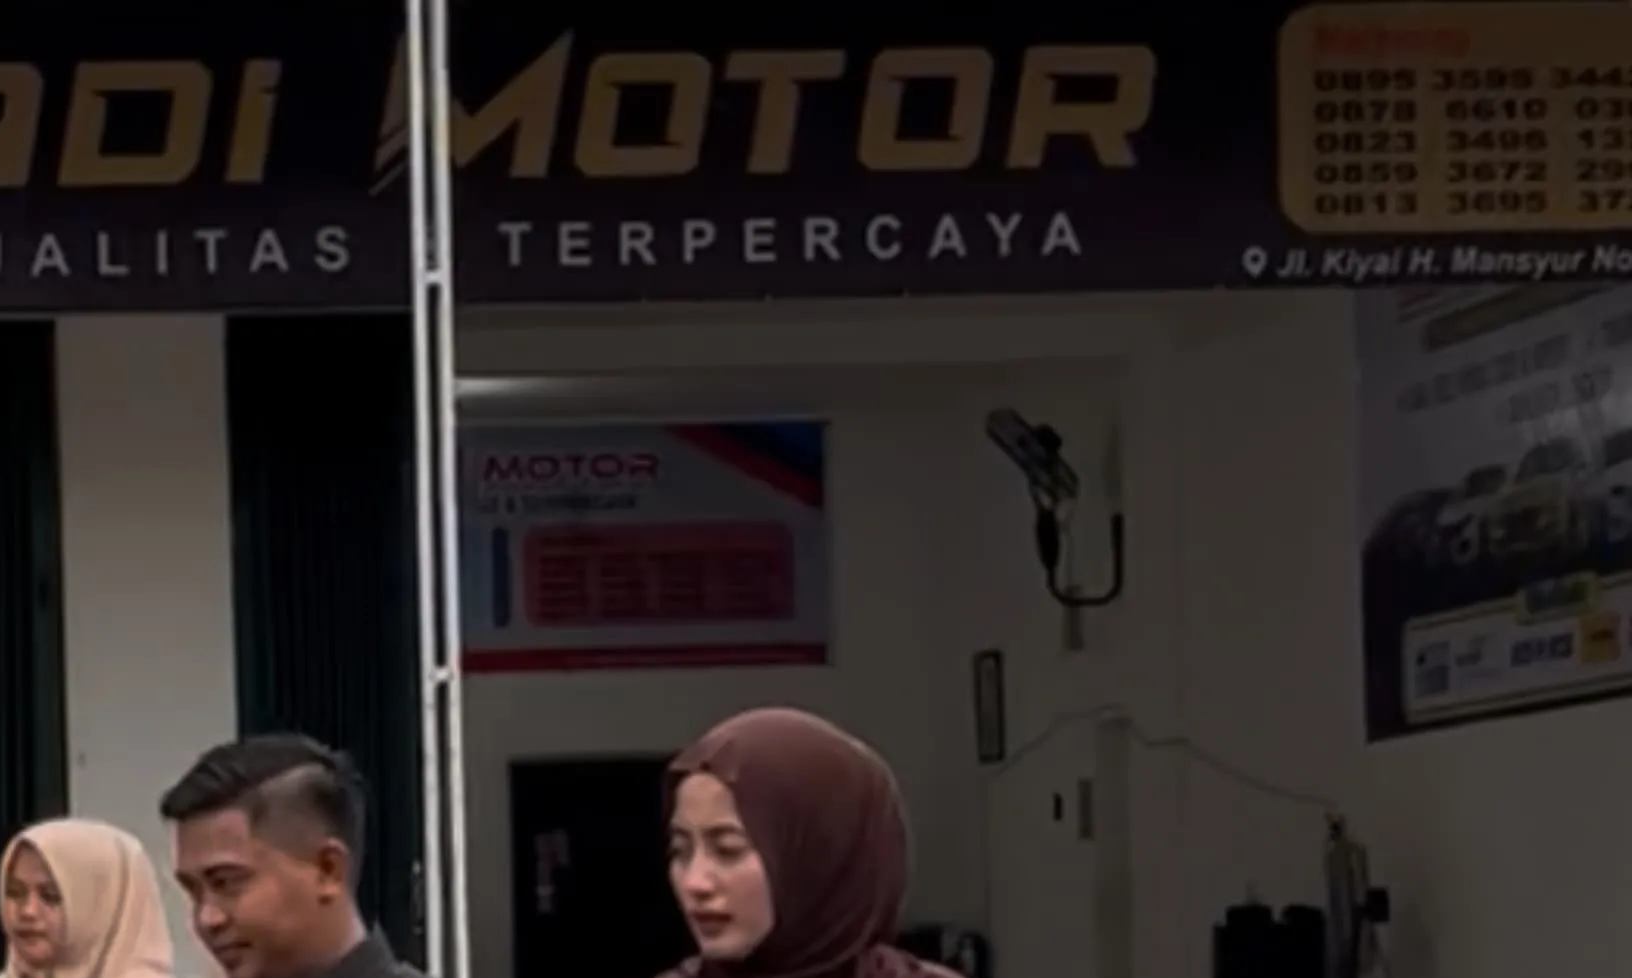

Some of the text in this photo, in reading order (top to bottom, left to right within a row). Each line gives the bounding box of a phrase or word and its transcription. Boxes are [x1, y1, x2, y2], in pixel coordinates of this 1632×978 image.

[1550, 66, 1632, 89] 344
[368, 27, 1157, 198] MOTOR
[1575, 96, 1632, 120] 03
[1576, 127, 1632, 151] 13
[1576, 158, 1632, 182] 29
[1577, 189, 1632, 213] 37
[498, 209, 1084, 268] TERPERCAYA
[1450, 244, 1587, 281] Mansyur
[483, 453, 660, 483] MOTOR
